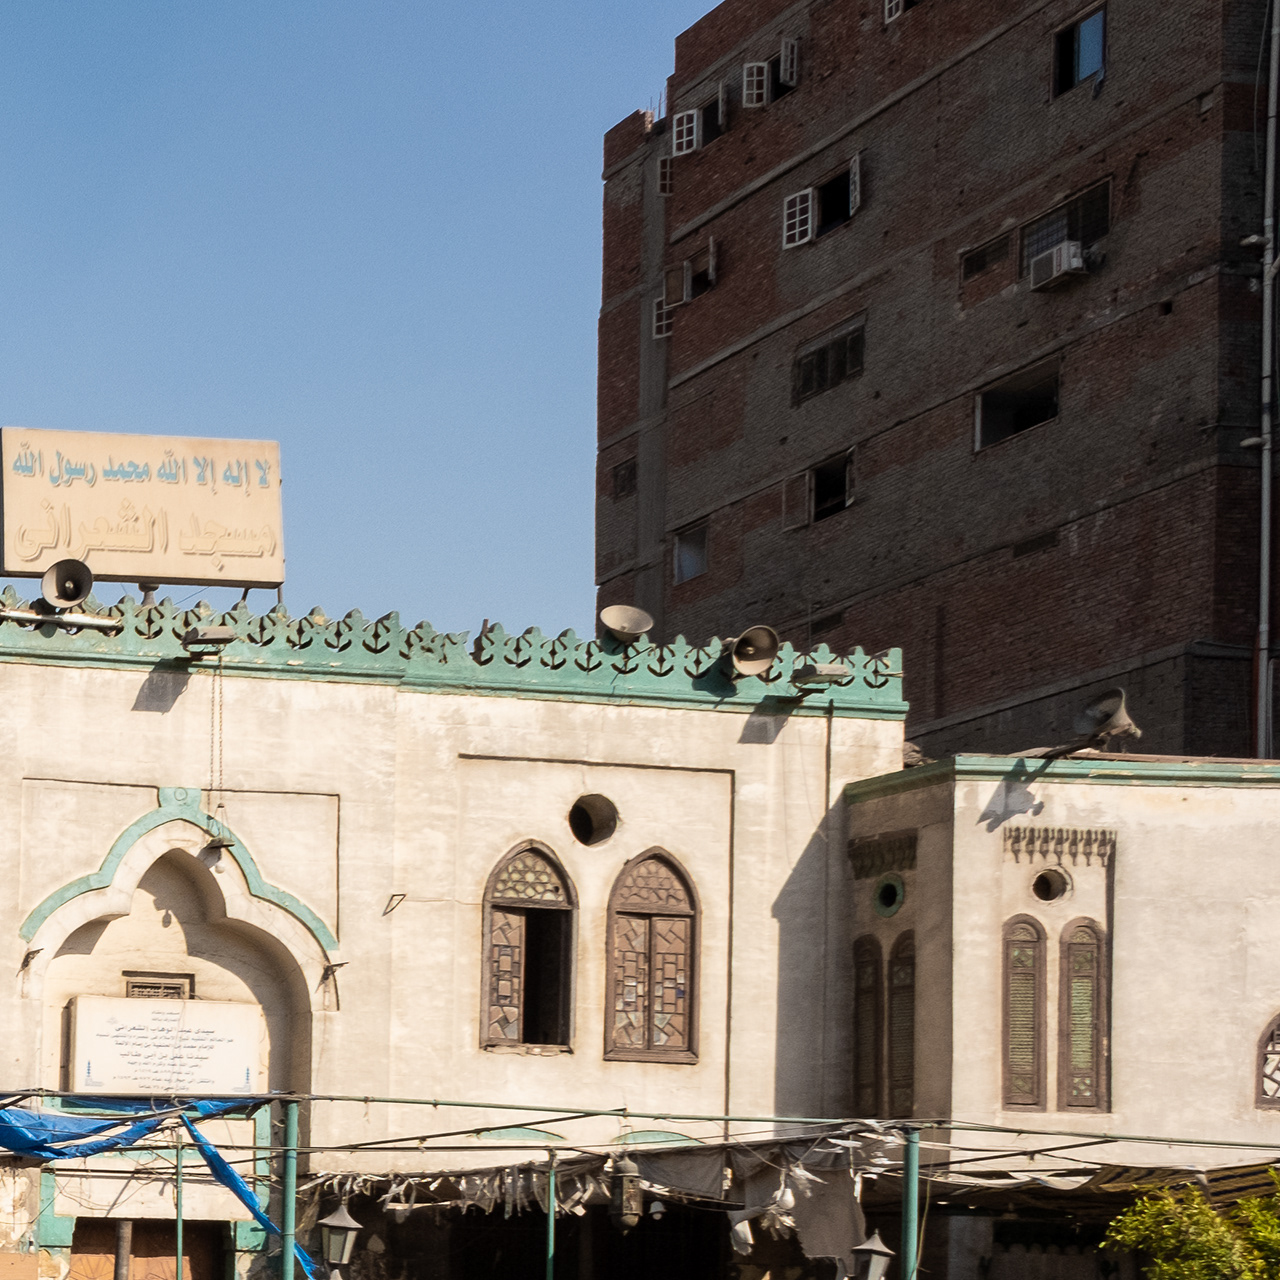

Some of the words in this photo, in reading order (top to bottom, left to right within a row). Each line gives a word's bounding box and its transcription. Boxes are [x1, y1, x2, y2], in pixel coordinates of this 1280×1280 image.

[12, 441, 44, 477] الله
[48, 449, 97, 487] رسول
[102, 454, 152, 482] محمد
[157, 448, 188, 485] الله
[192, 455, 218, 496] إلا
[255, 458, 271, 488] لا
[178, 511, 278, 572] مسجد
